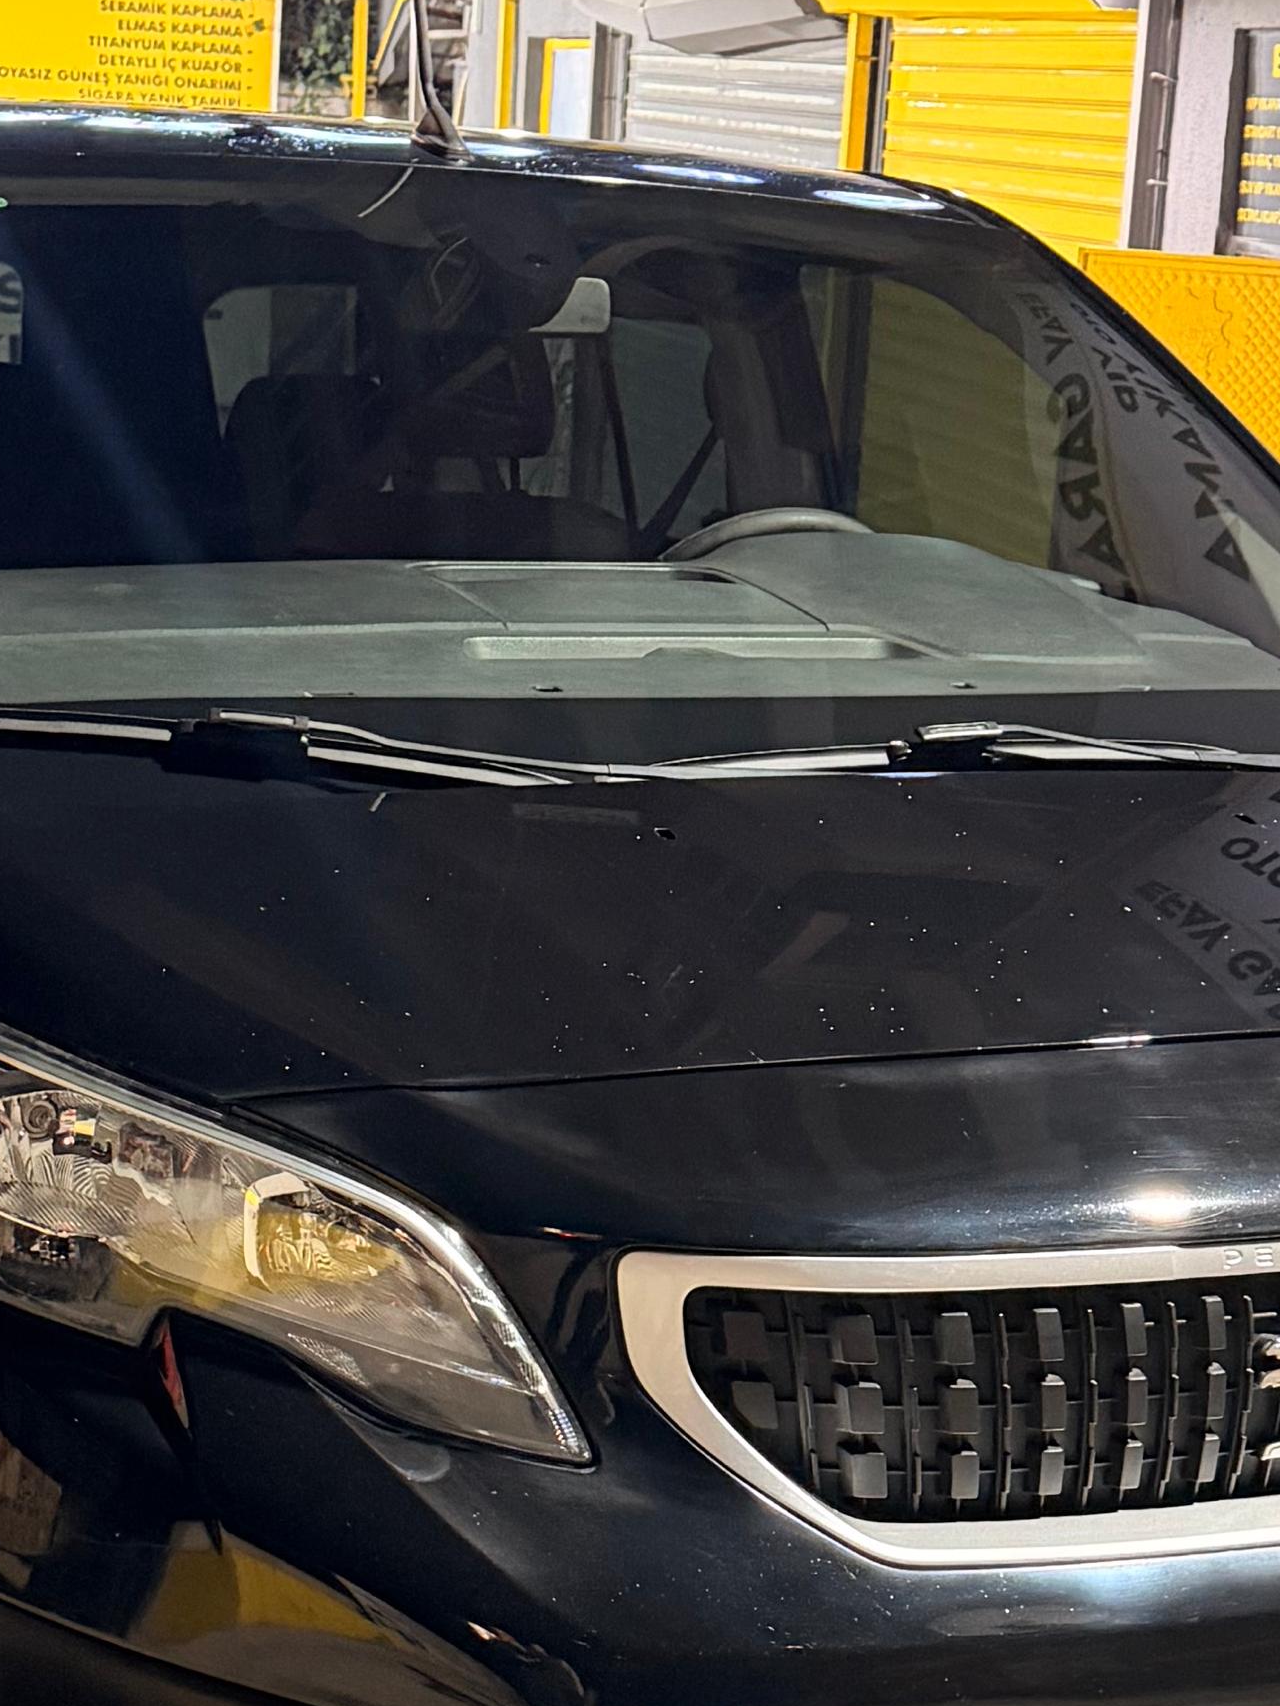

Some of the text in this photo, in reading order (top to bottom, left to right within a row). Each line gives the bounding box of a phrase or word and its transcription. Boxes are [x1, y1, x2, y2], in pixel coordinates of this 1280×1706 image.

[171, 3, 243, 20] KAPLAMA
[118, 19, 243, 37] ELMAS KAPLAMA
[171, 39, 242, 56] KAPLAMA
